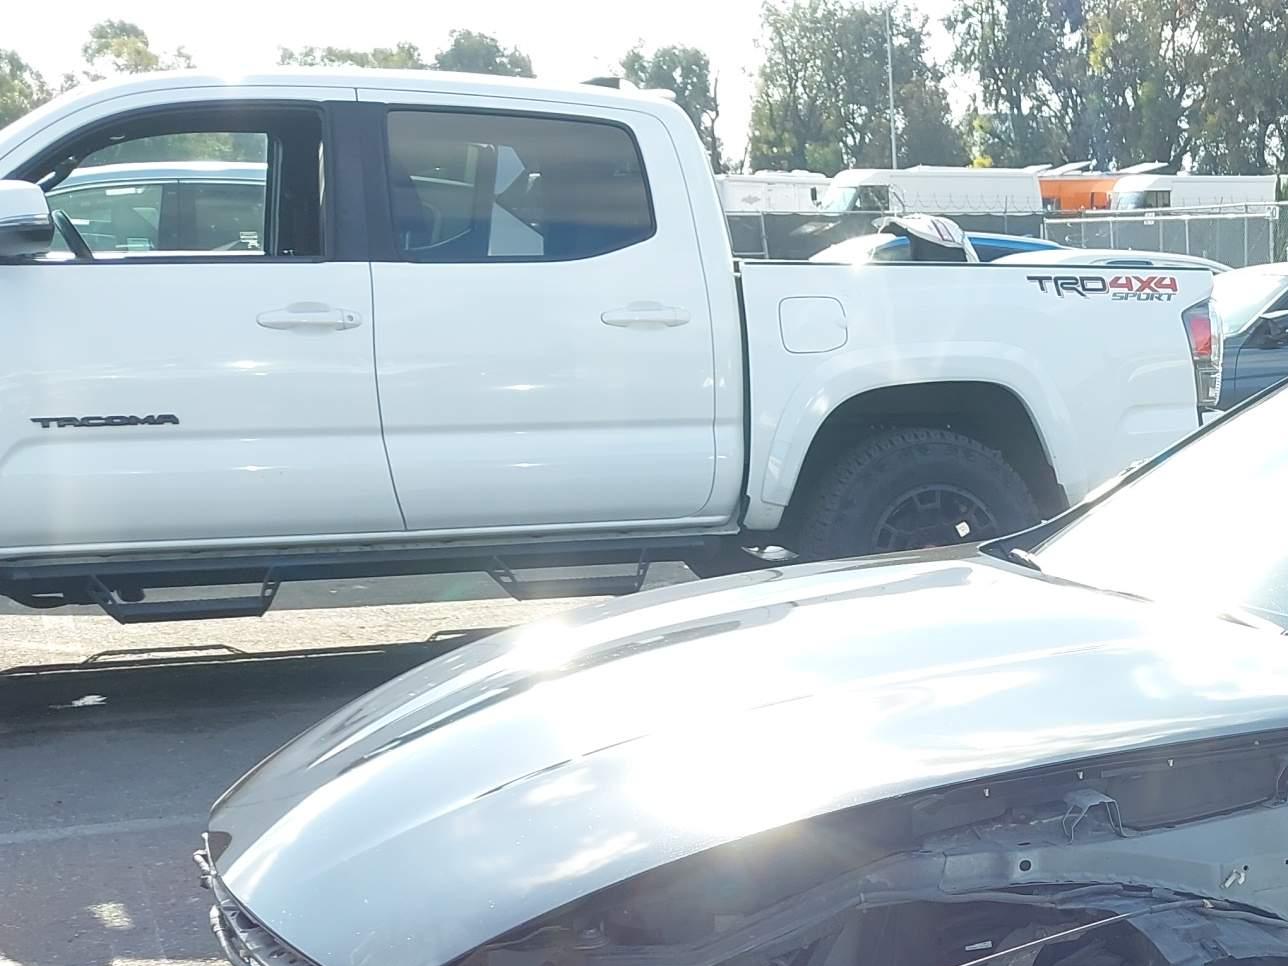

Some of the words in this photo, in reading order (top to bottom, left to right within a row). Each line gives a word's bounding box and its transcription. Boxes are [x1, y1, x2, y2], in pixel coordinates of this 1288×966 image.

[1026, 275, 1109, 298] TRD
[1111, 292, 1176, 301] SPORT
[30, 414, 180, 428] TACOMA
